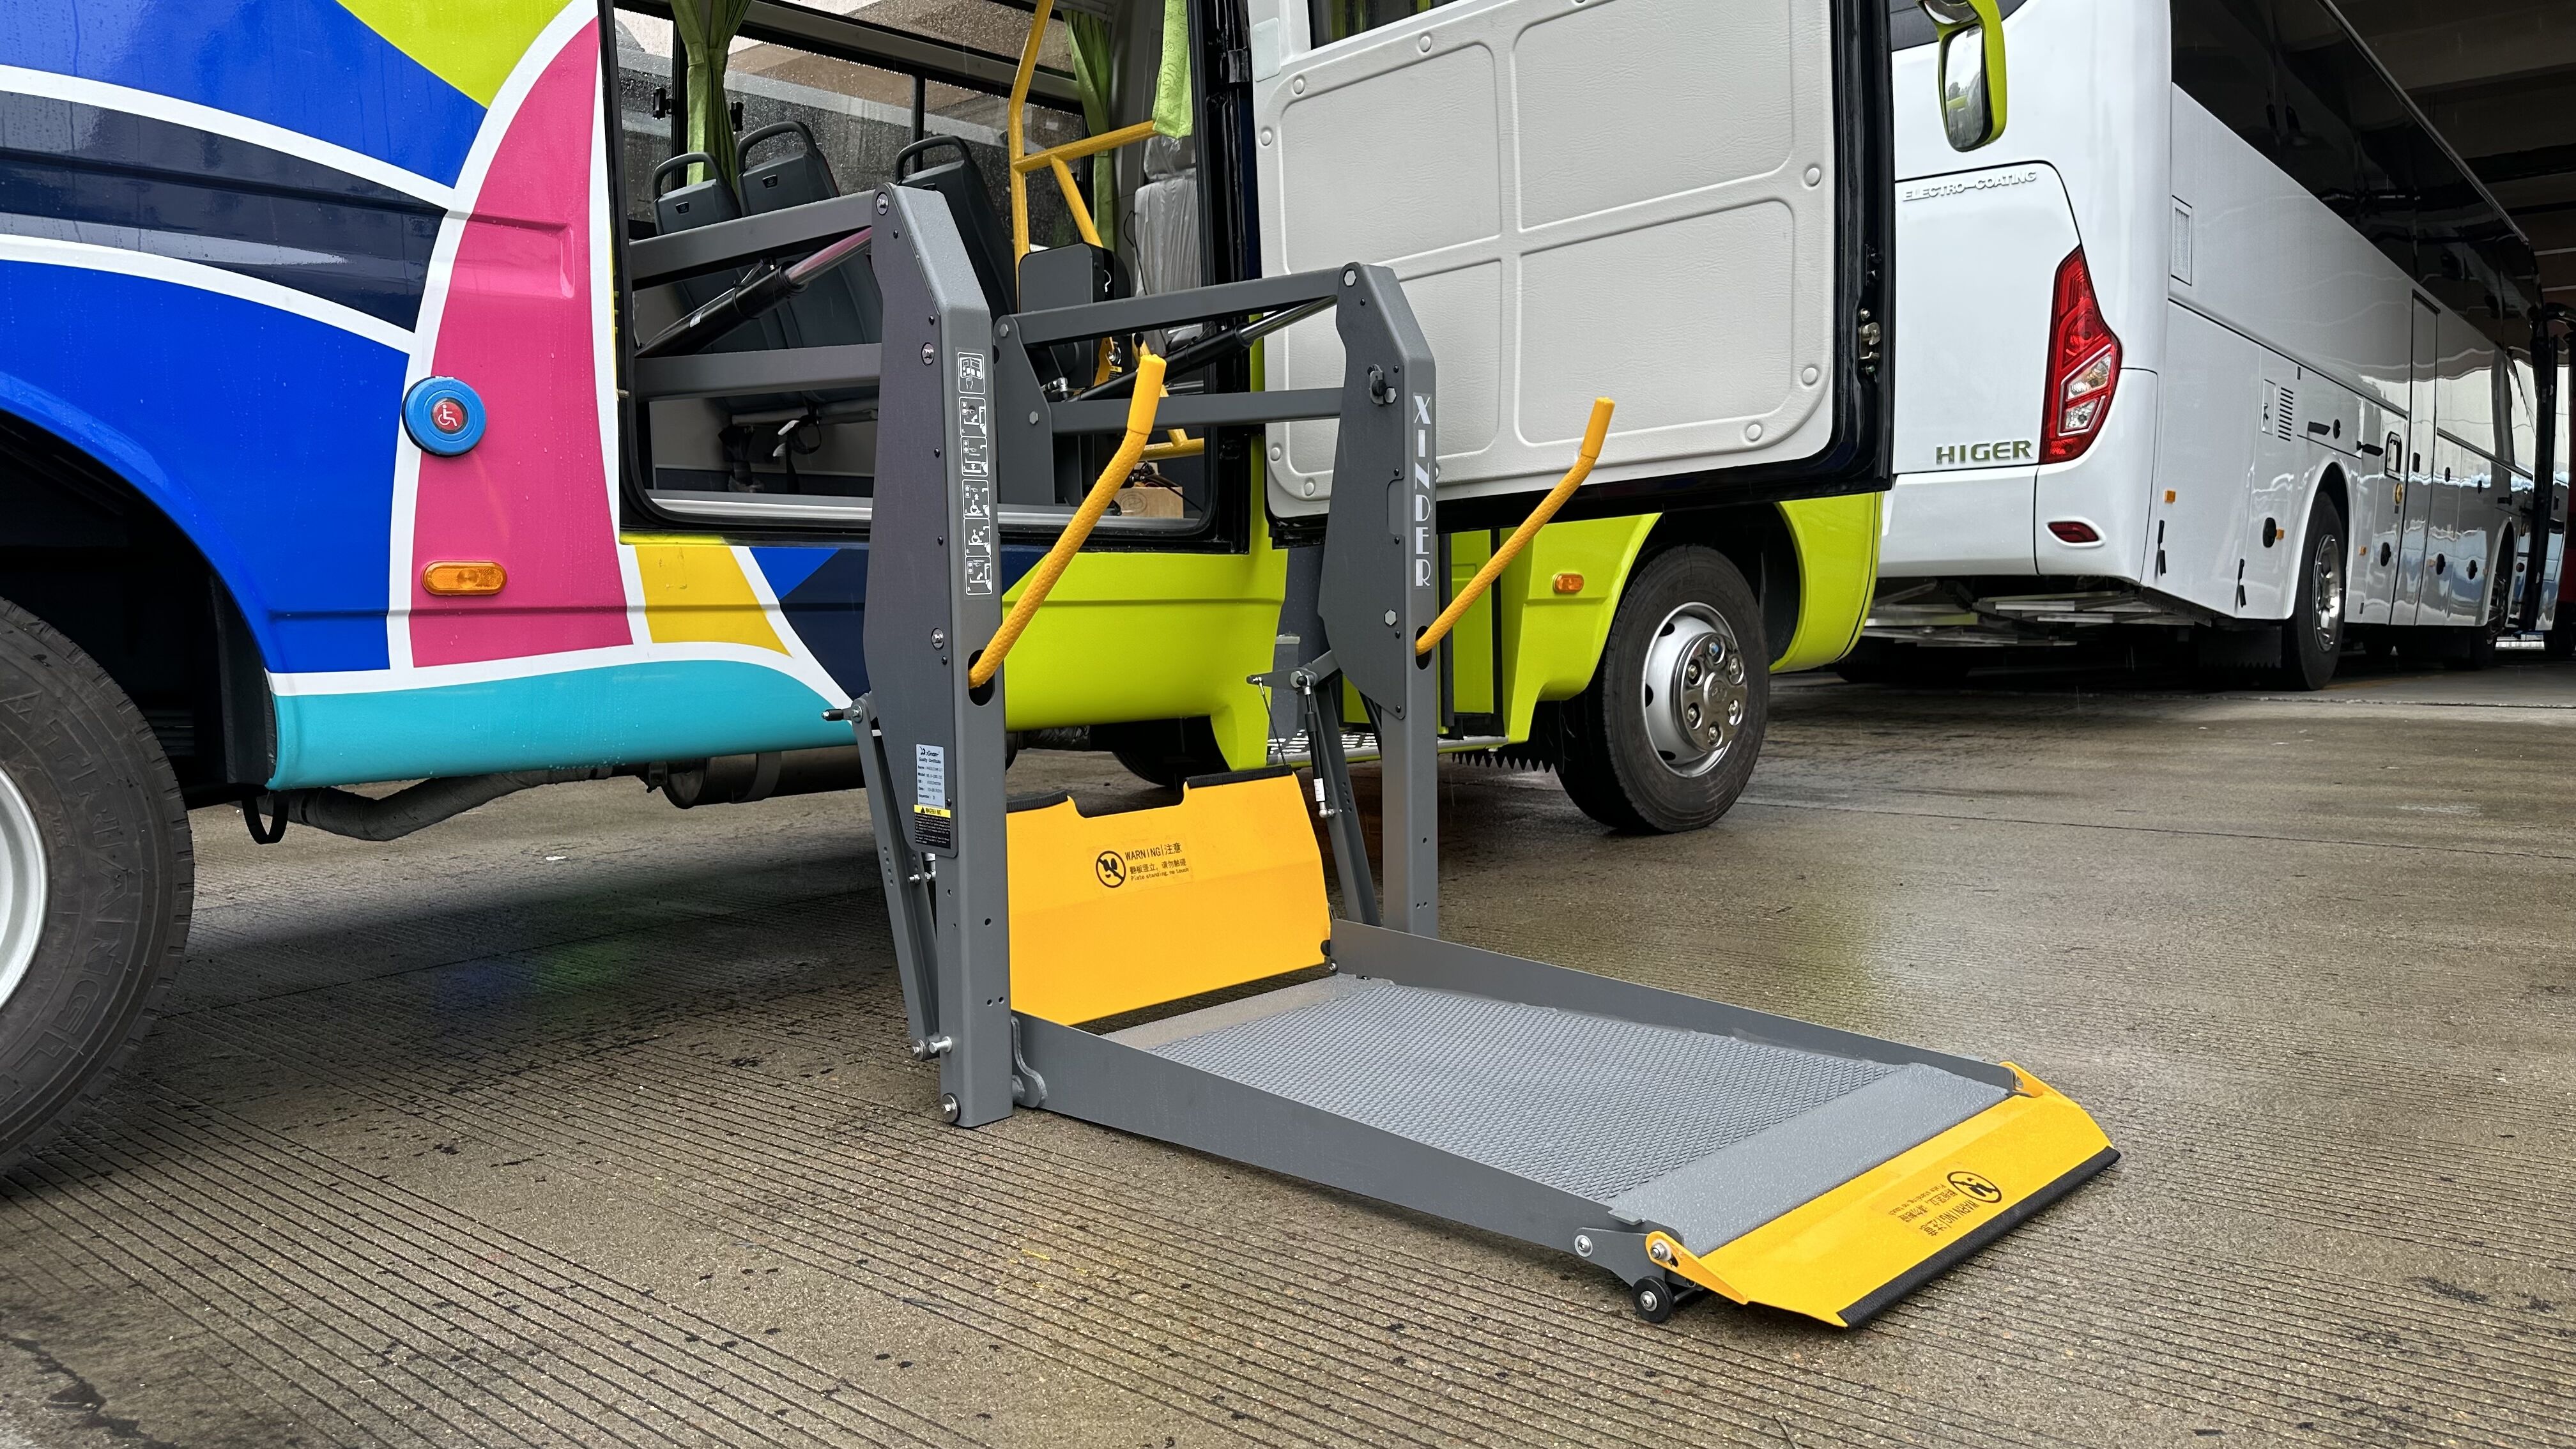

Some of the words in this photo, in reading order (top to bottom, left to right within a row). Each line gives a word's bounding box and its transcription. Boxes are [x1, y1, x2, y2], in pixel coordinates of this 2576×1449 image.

[1902, 171, 2037, 202] ELECTRO-COATING
[1935, 440, 2033, 466] HIGER
[1413, 395, 1432, 587] XINDER
[1124, 847, 1161, 861] WARNING
[1938, 1199, 1981, 1223] WARNING
